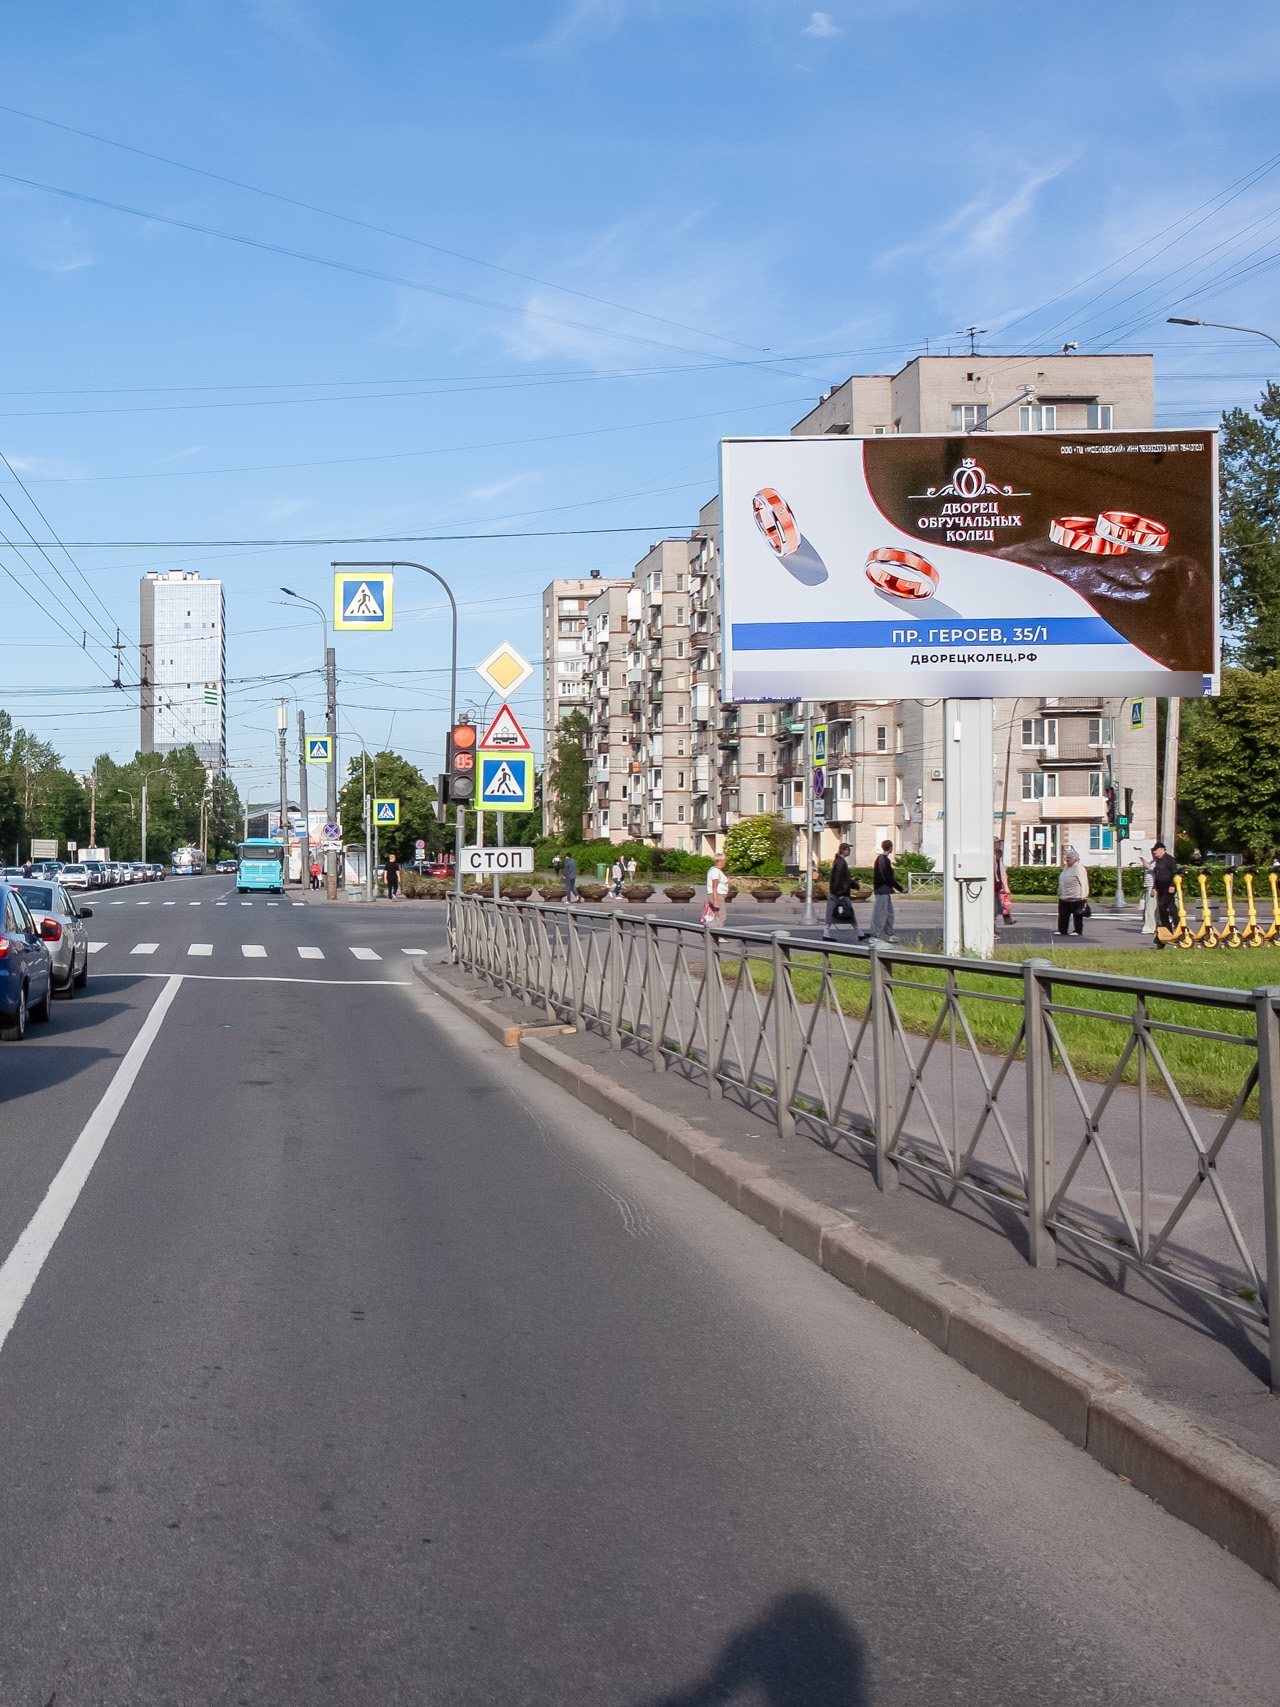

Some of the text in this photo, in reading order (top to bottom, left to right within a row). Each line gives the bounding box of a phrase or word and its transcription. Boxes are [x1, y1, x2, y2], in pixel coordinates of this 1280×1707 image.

[941, 501, 999, 515] ДВОРЕЦ
[918, 515, 1022, 529] ОБРУЧАЛЬНЫХ
[946, 529, 994, 542] КОЛЕЦ
[892, 625, 1048, 644] ПР. ГЕРОЕВ, 35/1
[910, 652, 1038, 665] ДВОРЕЦКОЛЕЦ.РФ
[470, 852, 522, 868] СТОП
